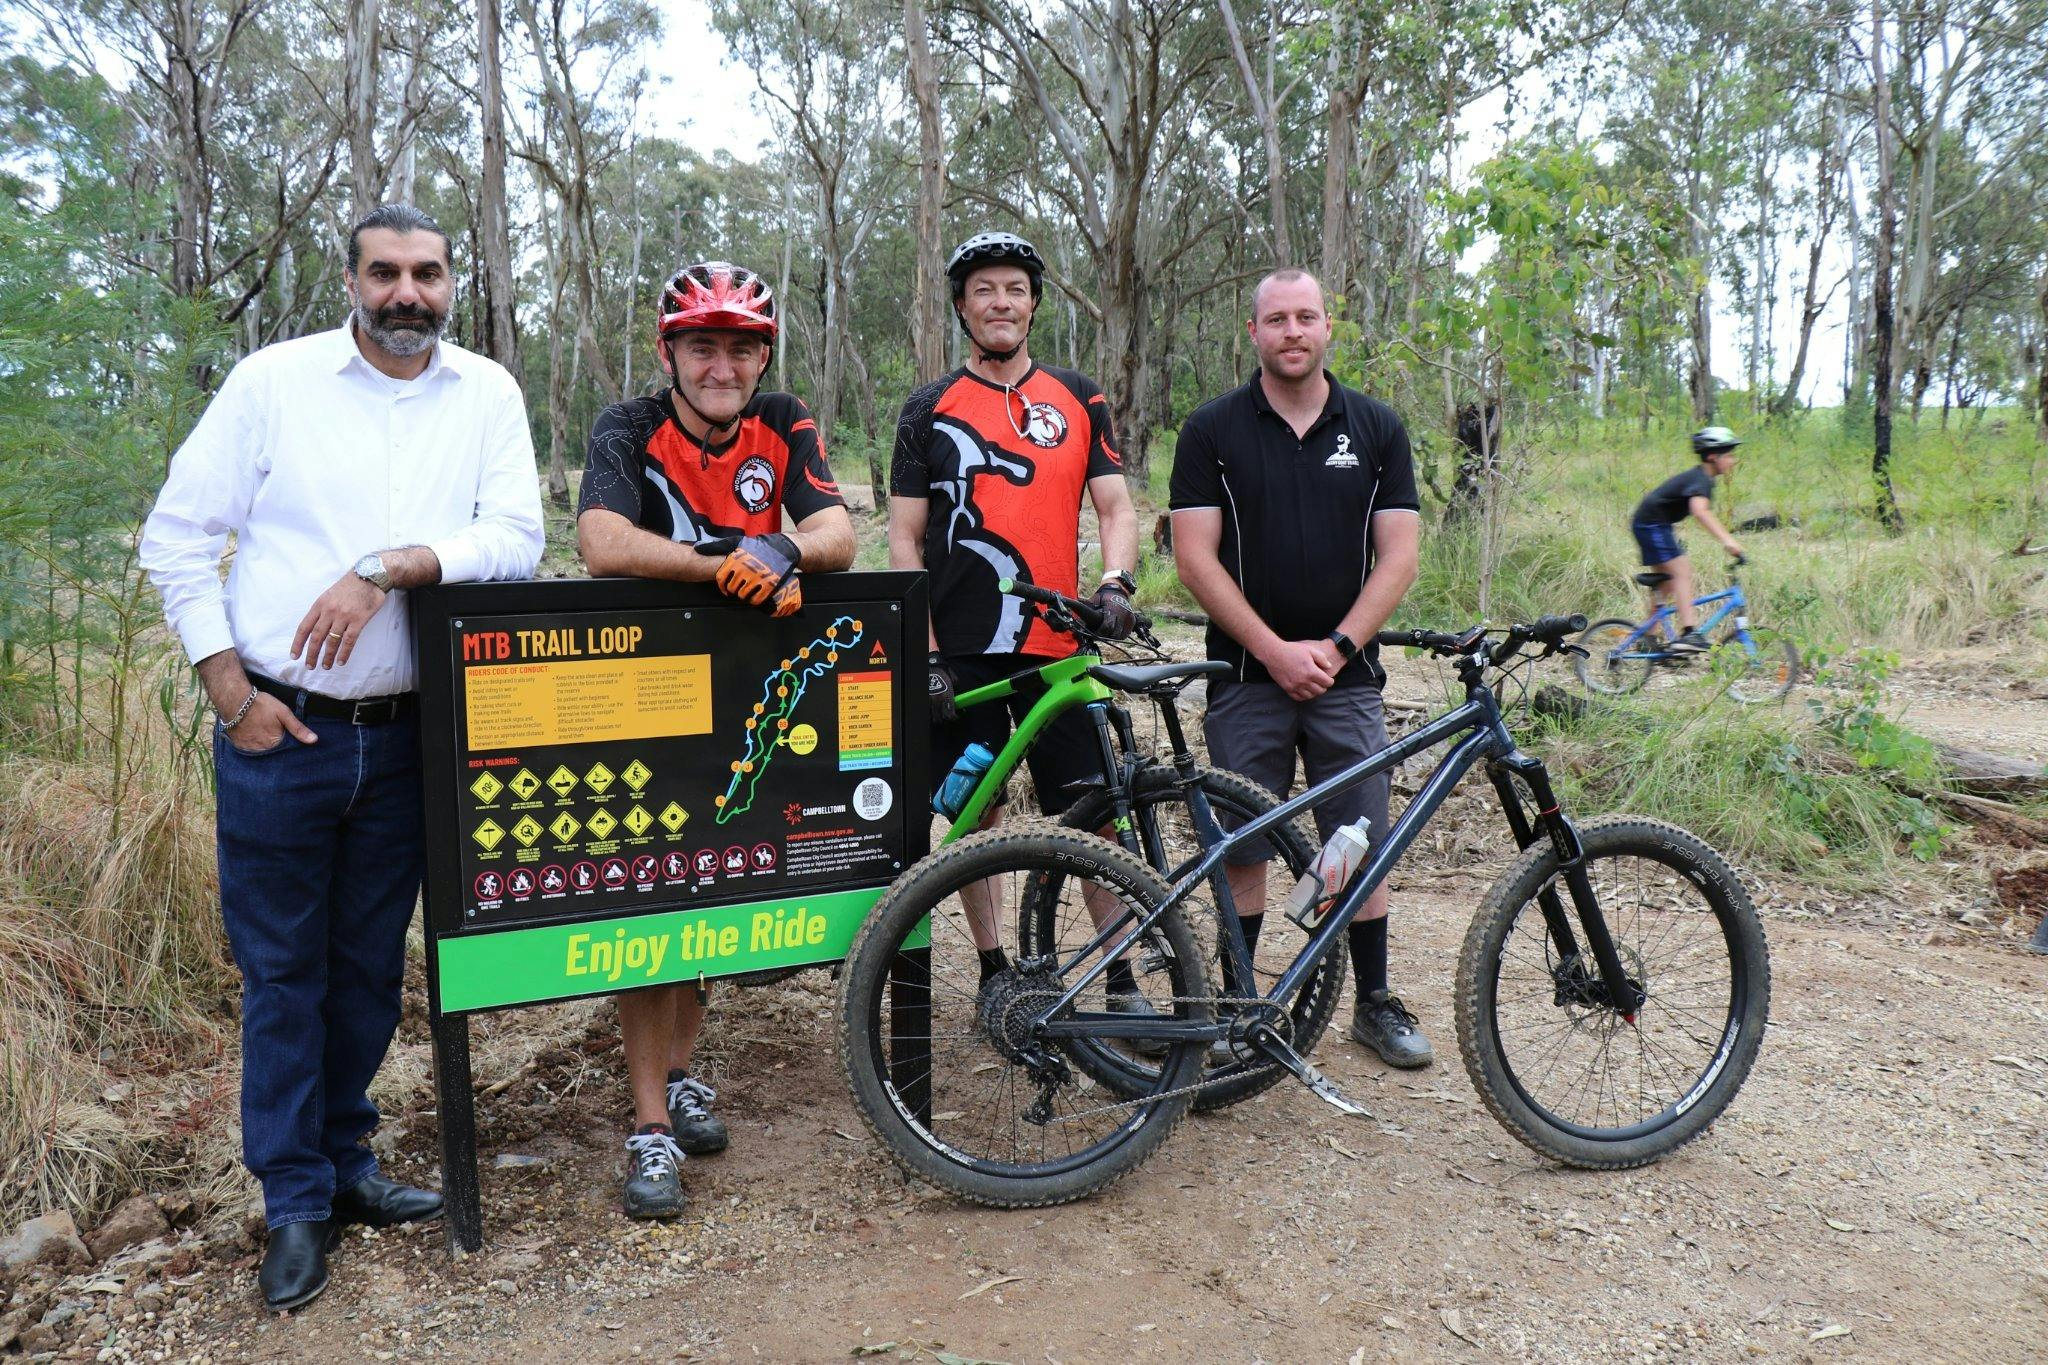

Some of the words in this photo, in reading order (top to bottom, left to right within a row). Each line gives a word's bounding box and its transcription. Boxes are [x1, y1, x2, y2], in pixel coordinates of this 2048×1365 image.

[735, 458, 755, 491] WOLLONDILL
[755, 502, 769, 511] CLUB
[463, 632, 510, 661] MTB
[516, 628, 582, 658] TRAIL
[588, 626, 642, 654] LOOP
[468, 760, 483, 768] RISK
[485, 758, 520, 767] WARNINGS:
[803, 804, 846, 817] CAMPBELLTOWN
[786, 828, 854, 841] campbelltown.nsw.gov.au
[1056, 852, 1097, 869] ISSUE
[1661, 840, 1697, 861] ISSUE
[1099, 866, 1138, 891] TEAM
[1693, 857, 1724, 887] TEAM
[565, 928, 670, 982] Enjoy
[680, 920, 739, 961] the
[750, 908, 827, 953] Ride
